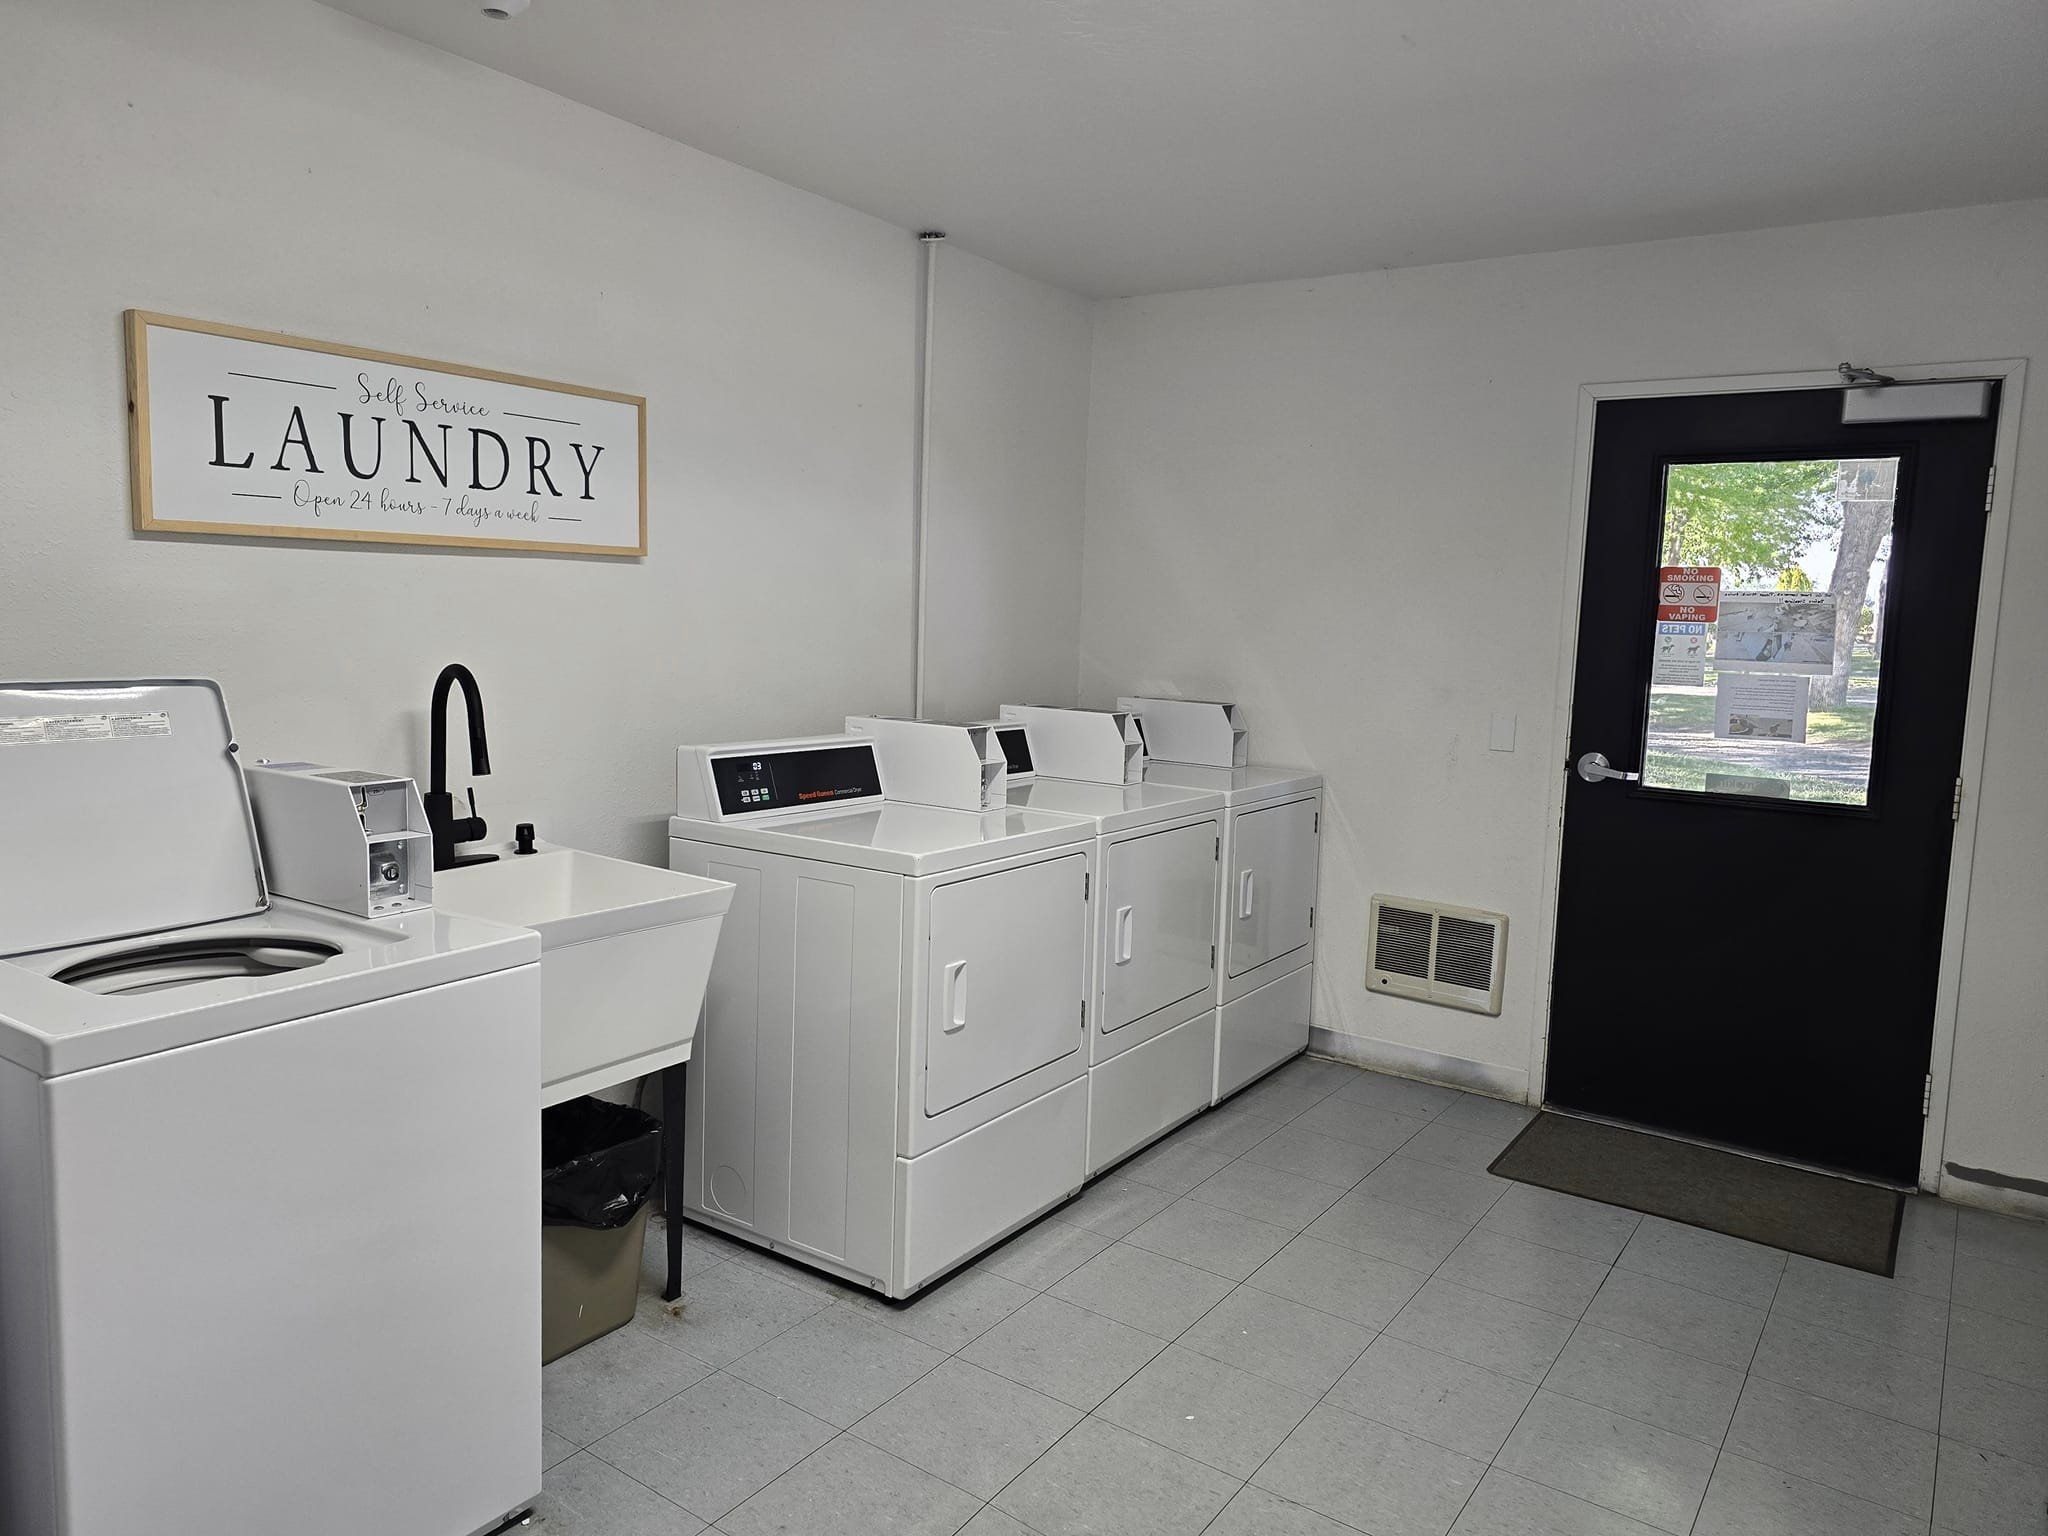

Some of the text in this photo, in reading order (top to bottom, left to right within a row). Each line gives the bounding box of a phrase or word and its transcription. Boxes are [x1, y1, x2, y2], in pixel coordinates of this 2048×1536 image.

[358, 372, 489, 416] Self Service
[208, 394, 605, 499] LAUNDRY
[293, 479, 345, 517] Open
[350, 490, 372, 510] 24
[380, 487, 426, 514] hours
[442, 497, 452, 515] 7
[456, 494, 491, 527] days
[494, 509, 504, 519] a
[507, 500, 539, 523] week
[1667, 574, 1714, 582] SMOKING
[1680, 606, 1695, 614] NO
[1669, 613, 1706, 621] VAPING
[799, 791, 817, 800] Speed
